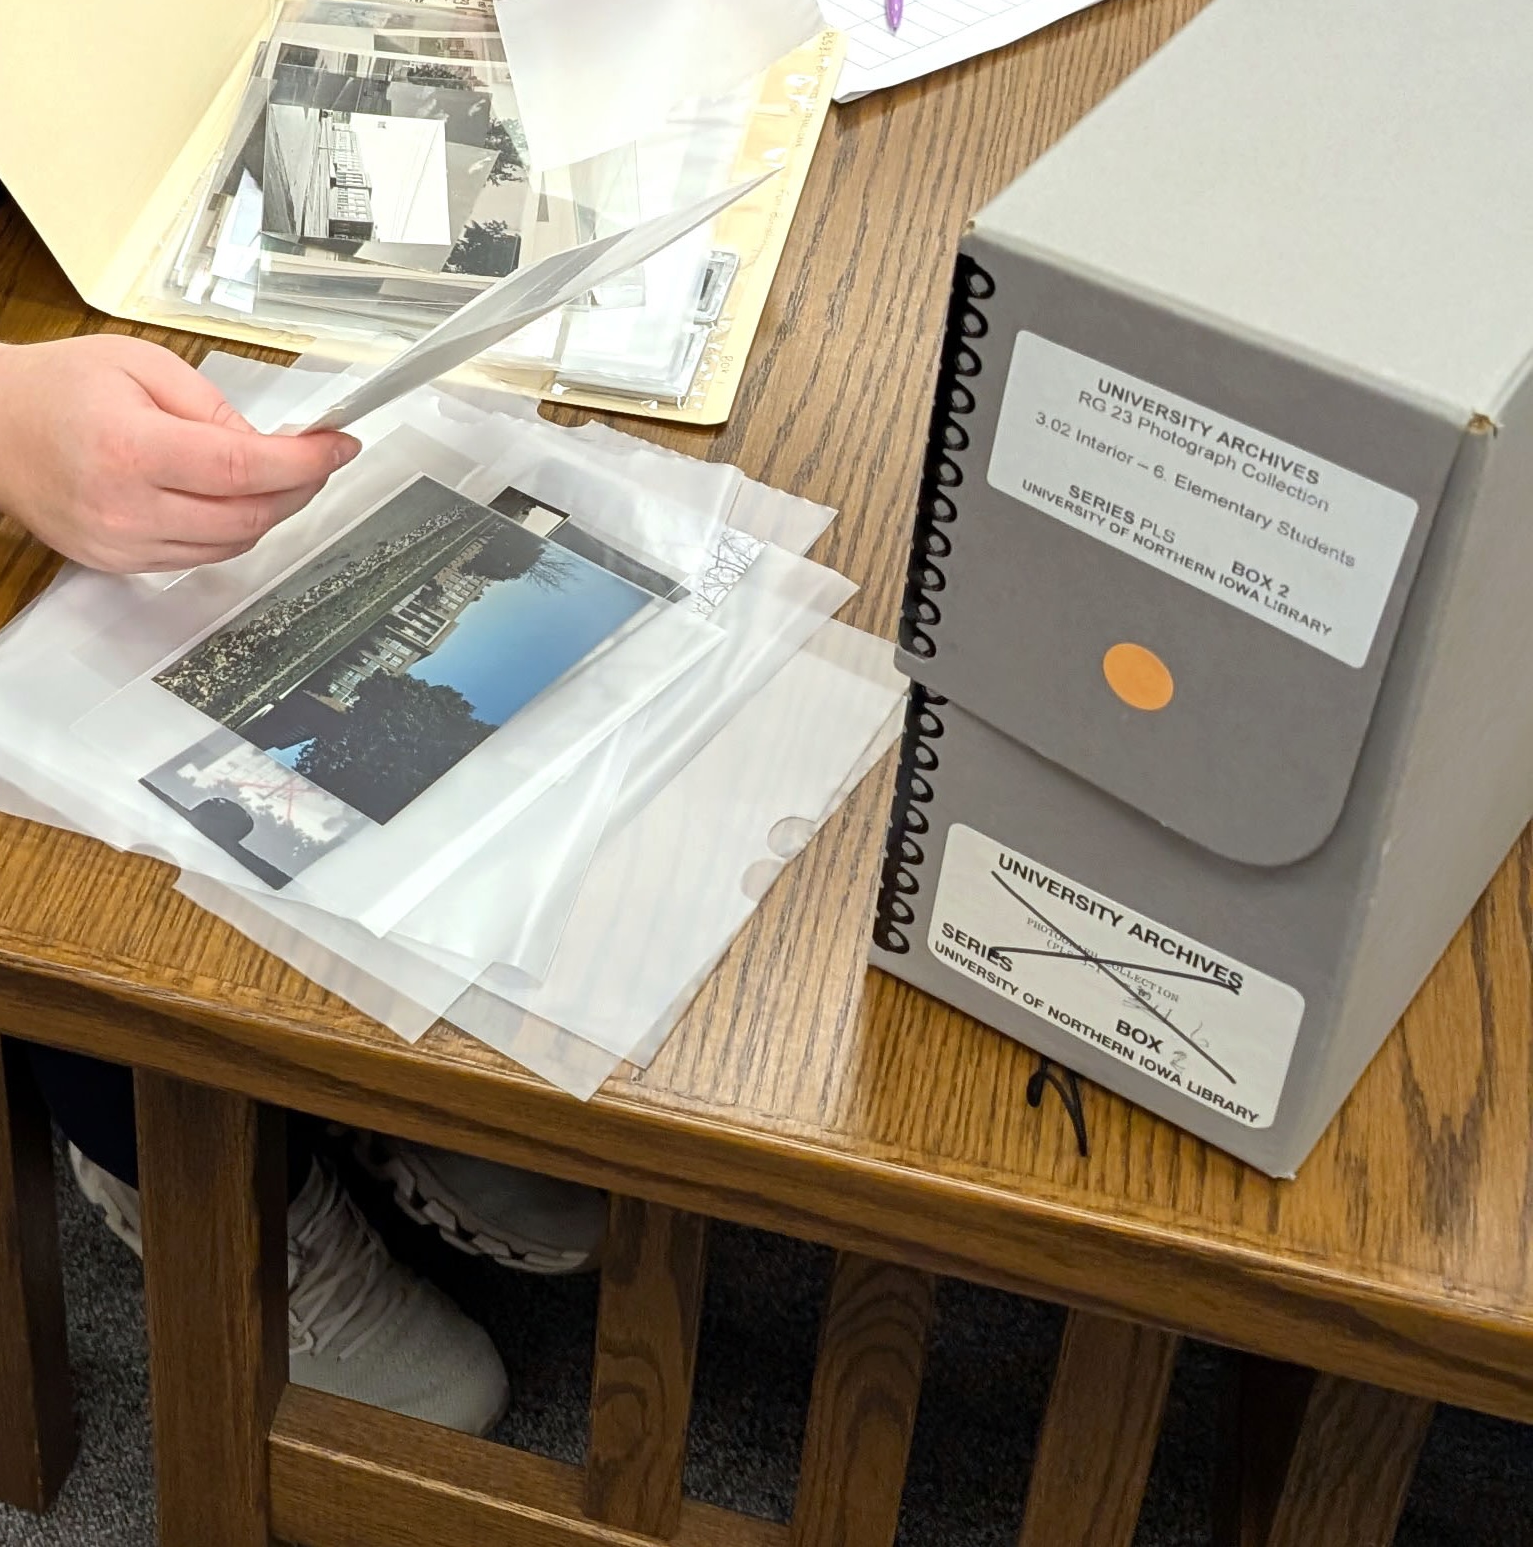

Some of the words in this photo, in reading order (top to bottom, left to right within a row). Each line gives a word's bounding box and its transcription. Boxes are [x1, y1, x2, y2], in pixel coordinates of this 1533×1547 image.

[1078, 390, 1106, 412] RG
[1111, 406, 1133, 424] 23
[1138, 416, 1236, 470] Photograph
[1242, 463, 1329, 512] Collection
[1098, 378, 1213, 437] UNIVERSITY
[1216, 432, 1319, 485] ARCHIVES
[1036, 412, 1070, 437] 3.02
[1076, 429, 1133, 465] Interior
[1174, 473, 1273, 530] Elementary
[1277, 520, 1356, 568] Students
[1069, 485, 1135, 525] SERIES
[1140, 518, 1176, 544] PLS
[1022, 479, 1106, 527] UNIVERSITY
[1110, 522, 1130, 537] OF
[1133, 533, 1216, 580] NORTHERN
[1219, 574, 1259, 602] IOWA
[1264, 596, 1333, 636] LIBRARY
[1231, 561, 1273, 591] BOX
[1278, 584, 1291, 598] 2
[942, 922, 1013, 972] SERIES
[999, 853, 1124, 927] UNIVERSITY
[1128, 923, 1244, 990] ARCHIVES
[935, 940, 1019, 996] UNIVERSITY
[1023, 992, 1044, 1010] OF
[1048, 1006, 1134, 1060] NORTHERN
[1139, 1055, 1181, 1086] IOWA
[1187, 1080, 1259, 1123] LIBRARY
[1116, 1019, 1163, 1054] BOX
